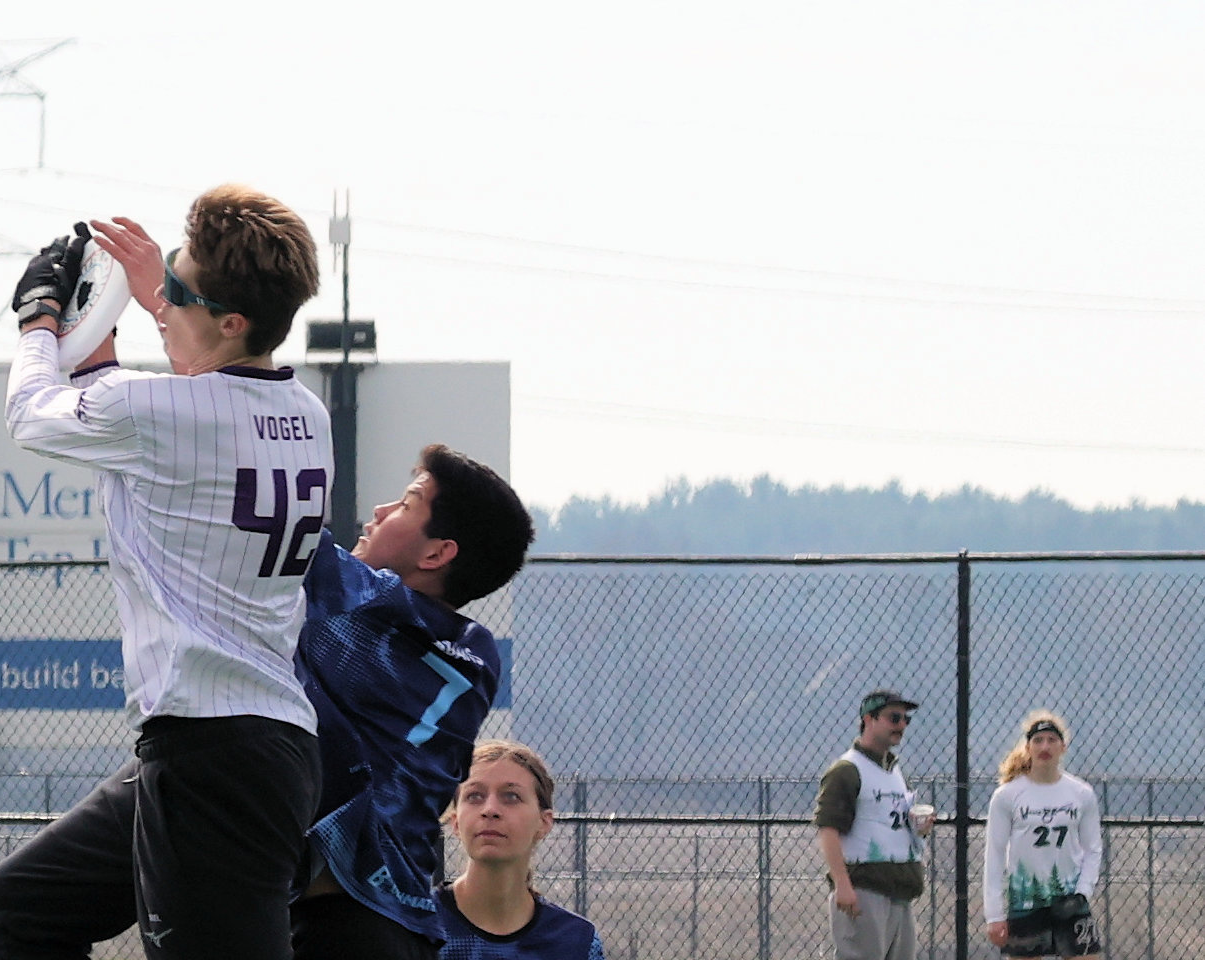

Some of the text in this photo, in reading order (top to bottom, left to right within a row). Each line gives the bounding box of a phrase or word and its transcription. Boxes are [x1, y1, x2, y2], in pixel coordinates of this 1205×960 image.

[253, 414, 314, 441] VOGEL
[232, 467, 328, 578] 42
[1, 659, 80, 690] build
[405, 650, 475, 749] 7
[1032, 825, 1069, 849] 27
